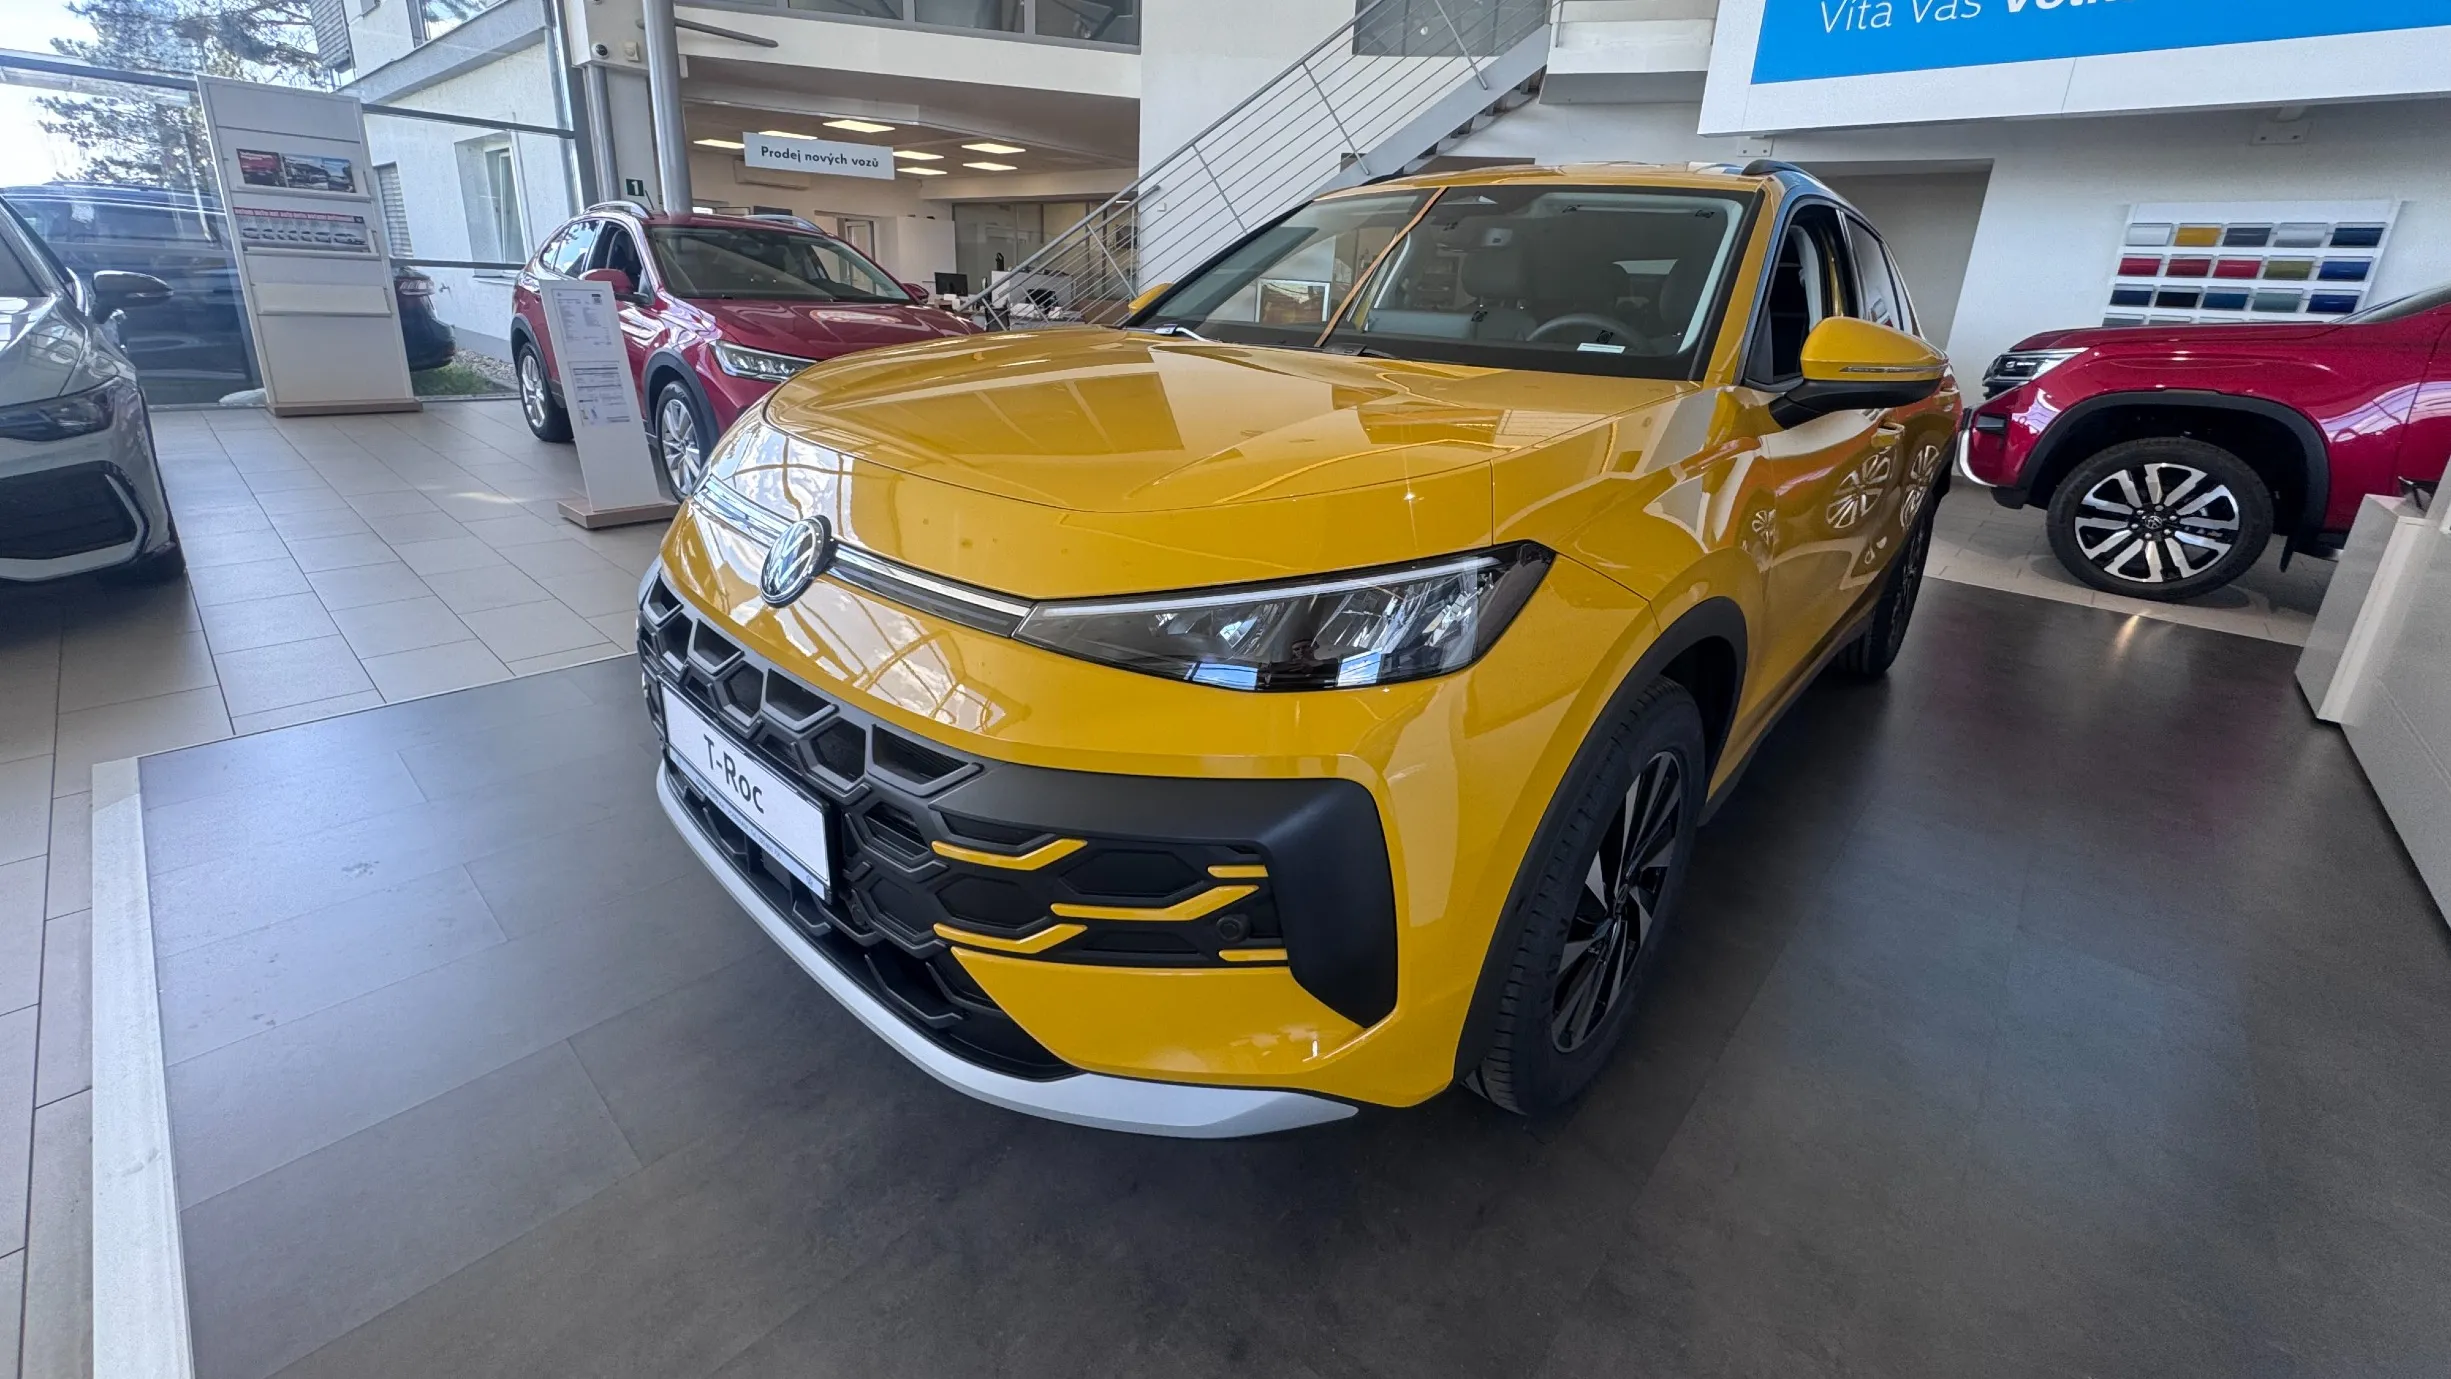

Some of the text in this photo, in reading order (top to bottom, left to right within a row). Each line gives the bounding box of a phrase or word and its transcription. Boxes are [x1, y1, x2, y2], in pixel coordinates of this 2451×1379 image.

[761, 146, 879, 167] Prodej nových vozů
[631, 180, 640, 196] 1
